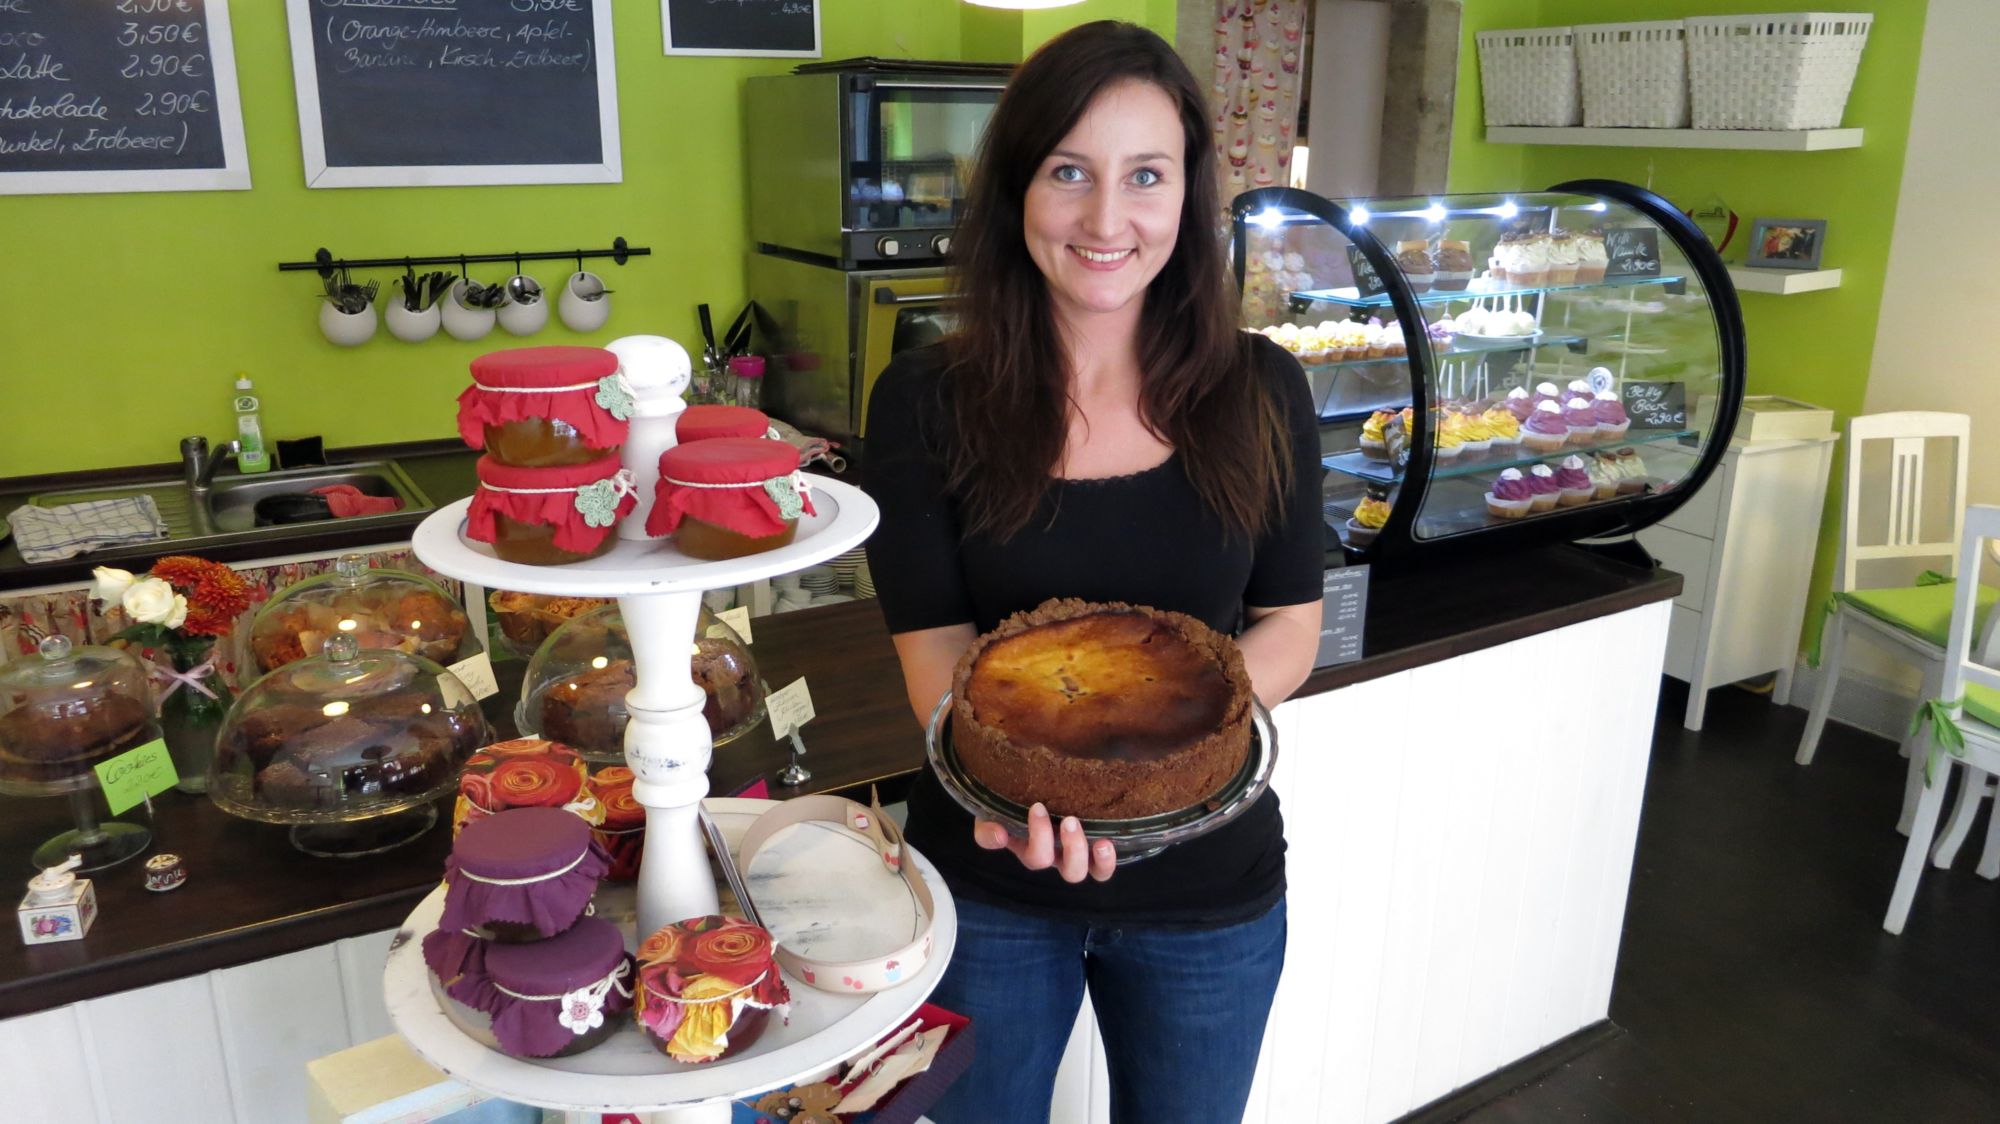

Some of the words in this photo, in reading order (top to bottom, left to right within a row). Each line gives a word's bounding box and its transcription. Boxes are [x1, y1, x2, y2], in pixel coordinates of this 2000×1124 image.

[116, 22, 202, 47] 3,50€
[516, 19, 574, 44] Apfel-
[120, 53, 205, 79] 2,90€
[135, 89, 210, 116] 2,90€
